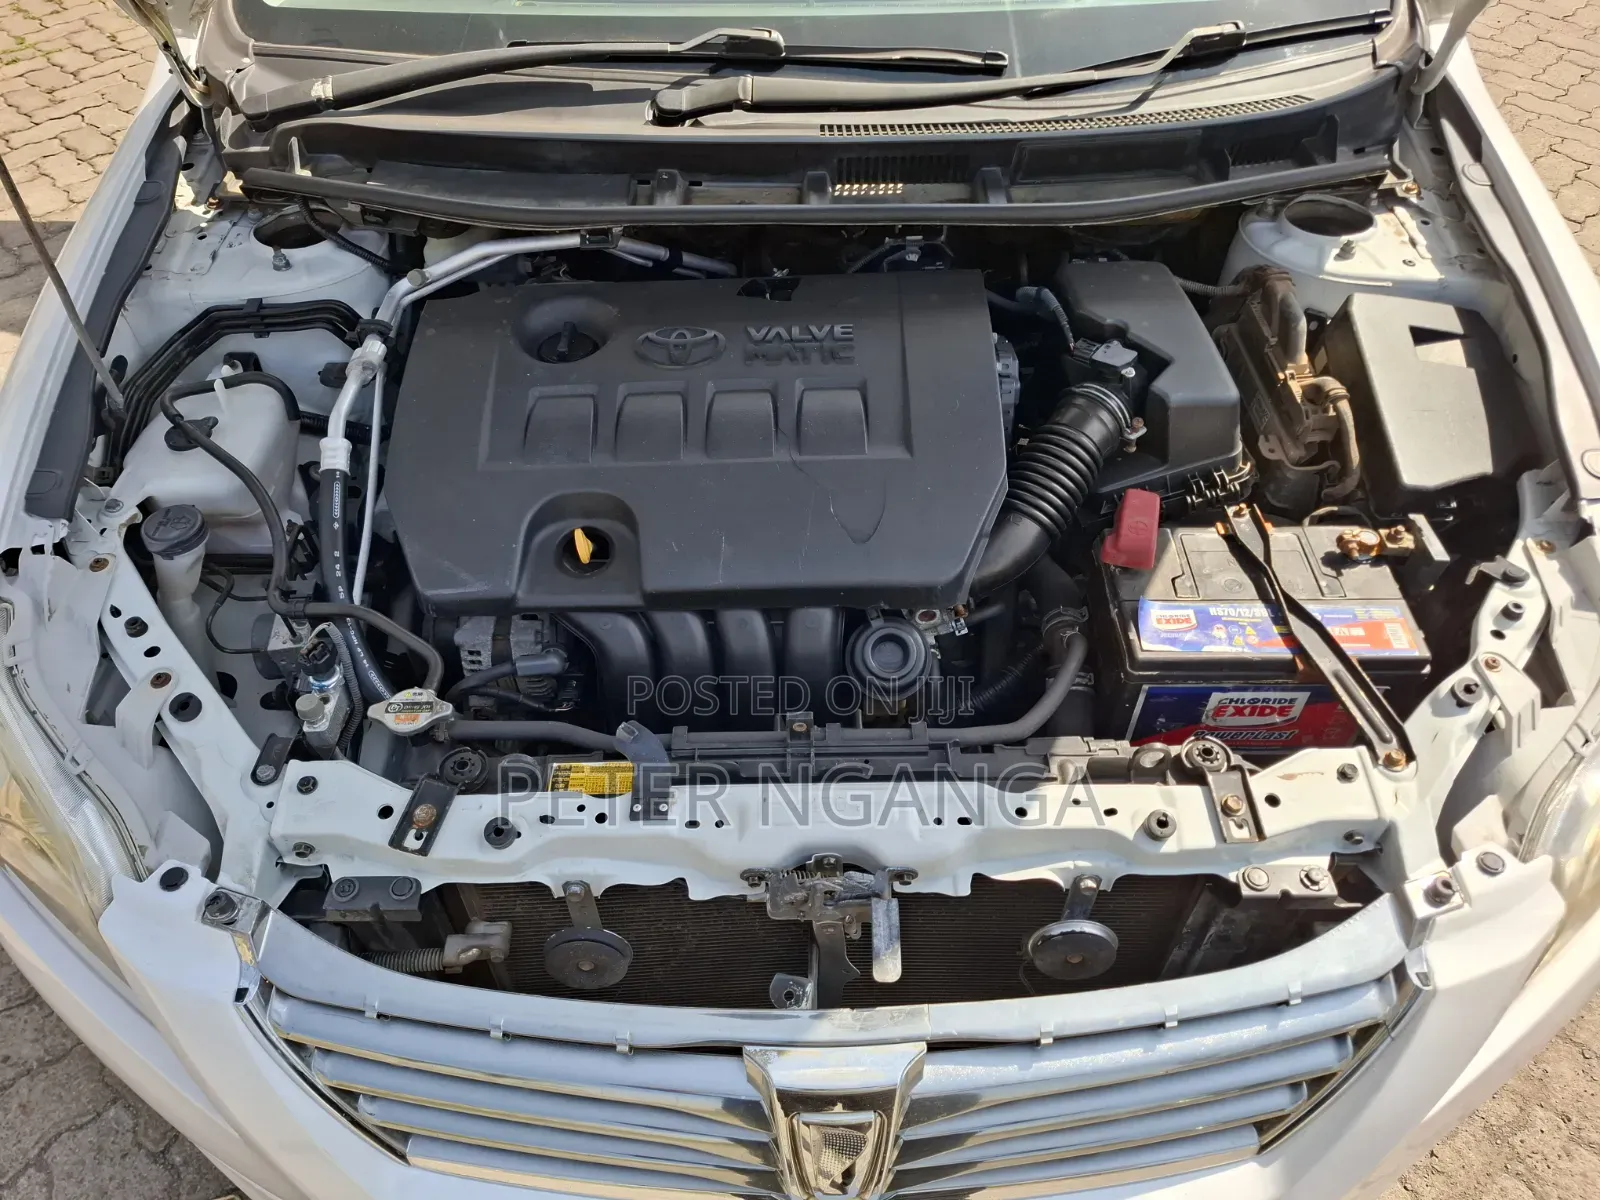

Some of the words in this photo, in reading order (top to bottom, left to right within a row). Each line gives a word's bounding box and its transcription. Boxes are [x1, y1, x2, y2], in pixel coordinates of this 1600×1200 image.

[745, 324, 854, 342] VALVE
[1155, 617, 1192, 625] EXIDE
[1218, 697, 1299, 705] CHLORIDE
[1211, 704, 1297, 718] EXIDE
